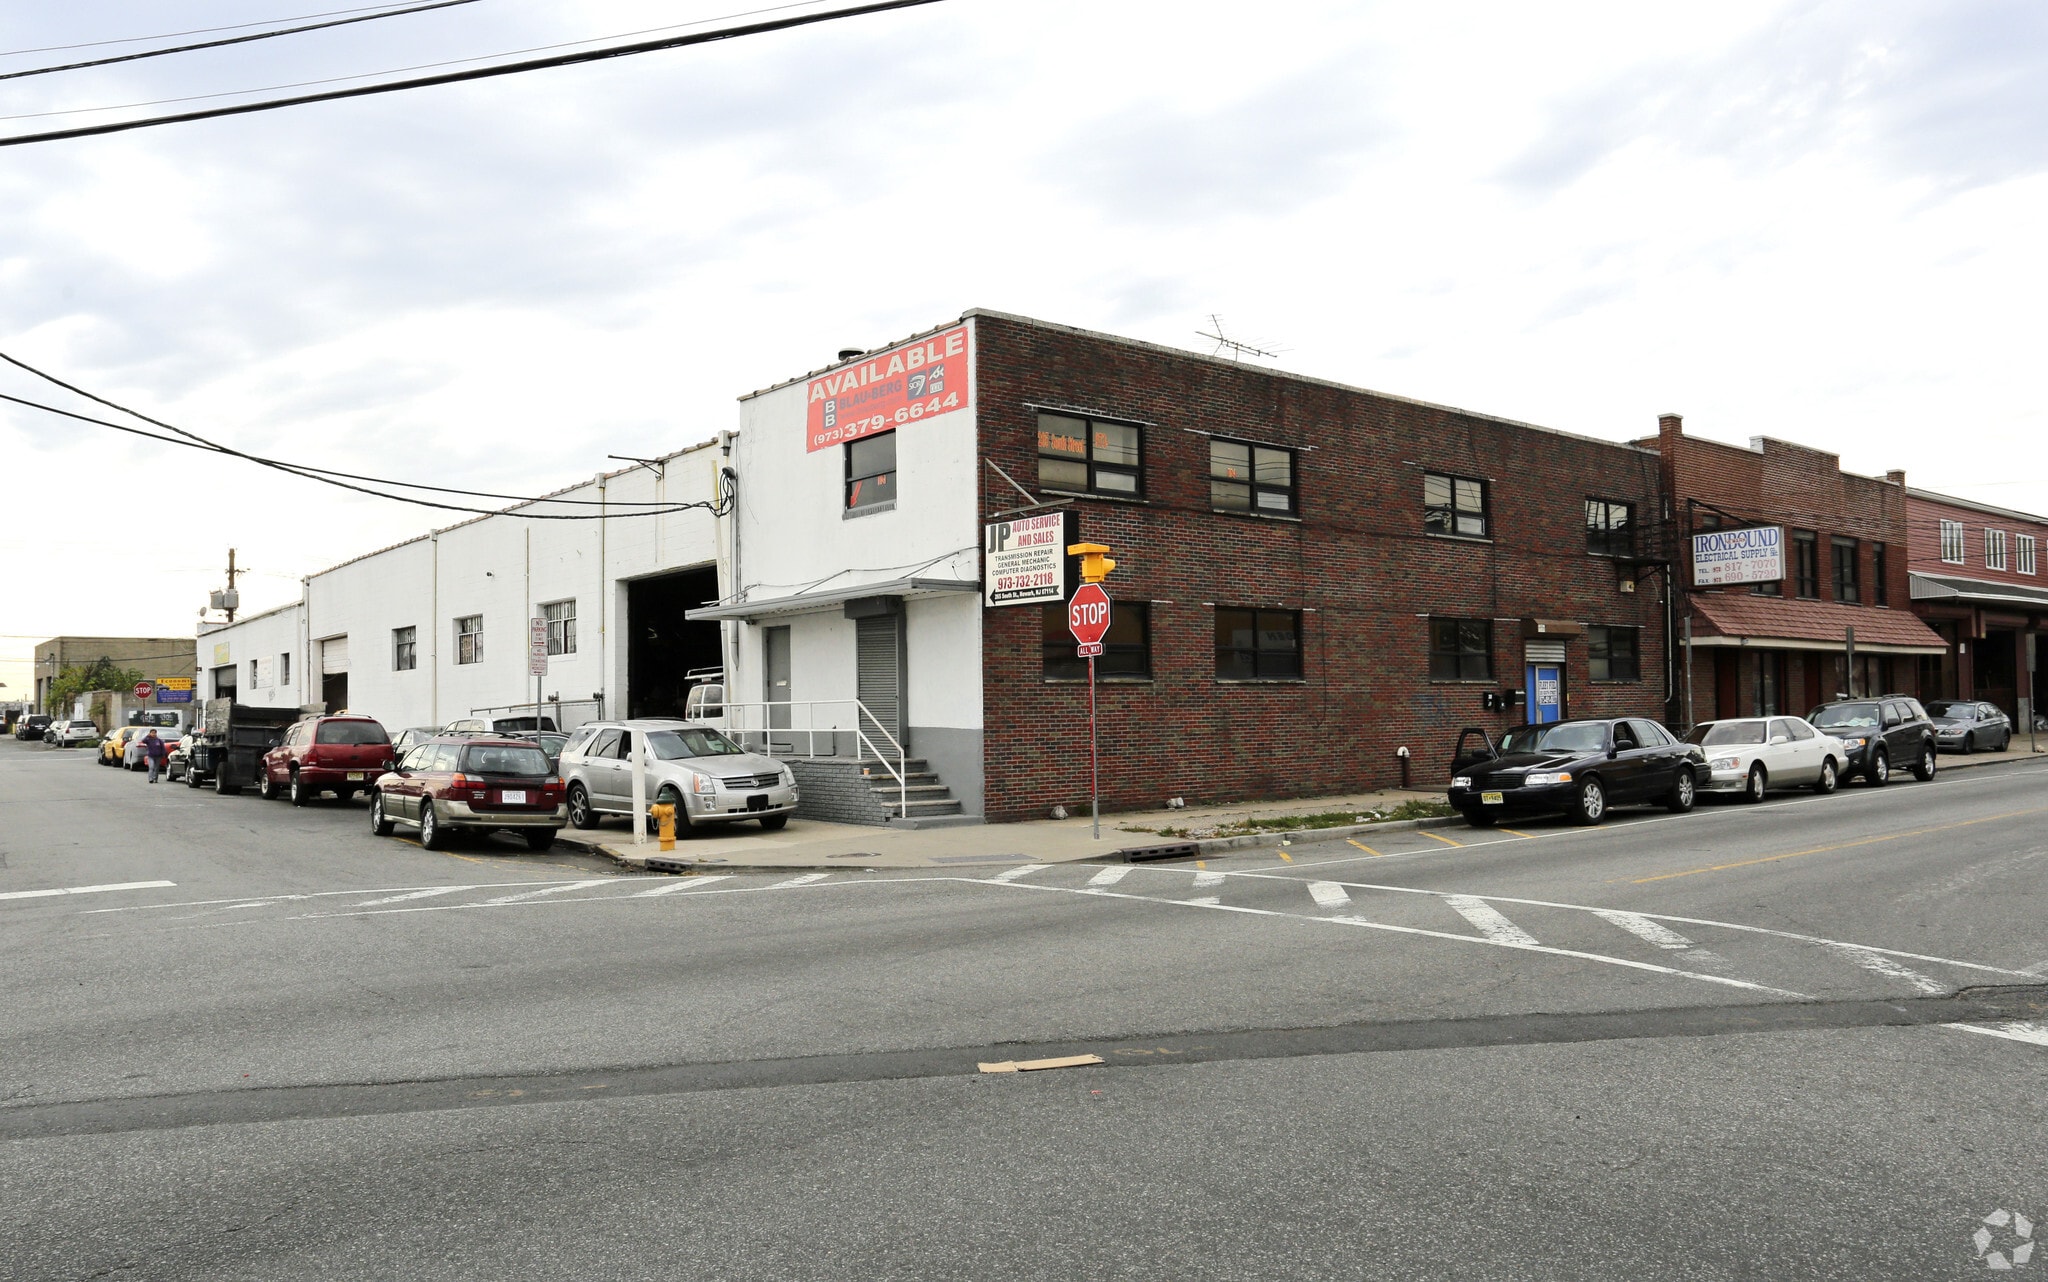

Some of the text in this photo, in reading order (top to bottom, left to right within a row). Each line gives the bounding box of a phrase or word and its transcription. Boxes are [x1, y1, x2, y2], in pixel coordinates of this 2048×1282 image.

[810, 332, 963, 403] AVAILABLE
[1012, 514, 1060, 533] AUTO SERVICE
[988, 523, 1011, 554] JP
[1018, 530, 1054, 547] AND SALES
[1695, 528, 1778, 553] IRONBOUND
[995, 549, 1053, 562] TRANSMISSION REPAIR
[998, 556, 1050, 569] GENERAL MECHANIC
[1696, 551, 1738, 563] ELECTRICAL
[1741, 548, 1768, 559] SUPPLY
[992, 563, 1057, 577] COMPUTER DIAGNOSTICS
[998, 572, 1053, 590] 973-732-2118
[1072, 601, 1107, 627] STOP
[1080, 645, 1100, 655] ALL WAY
